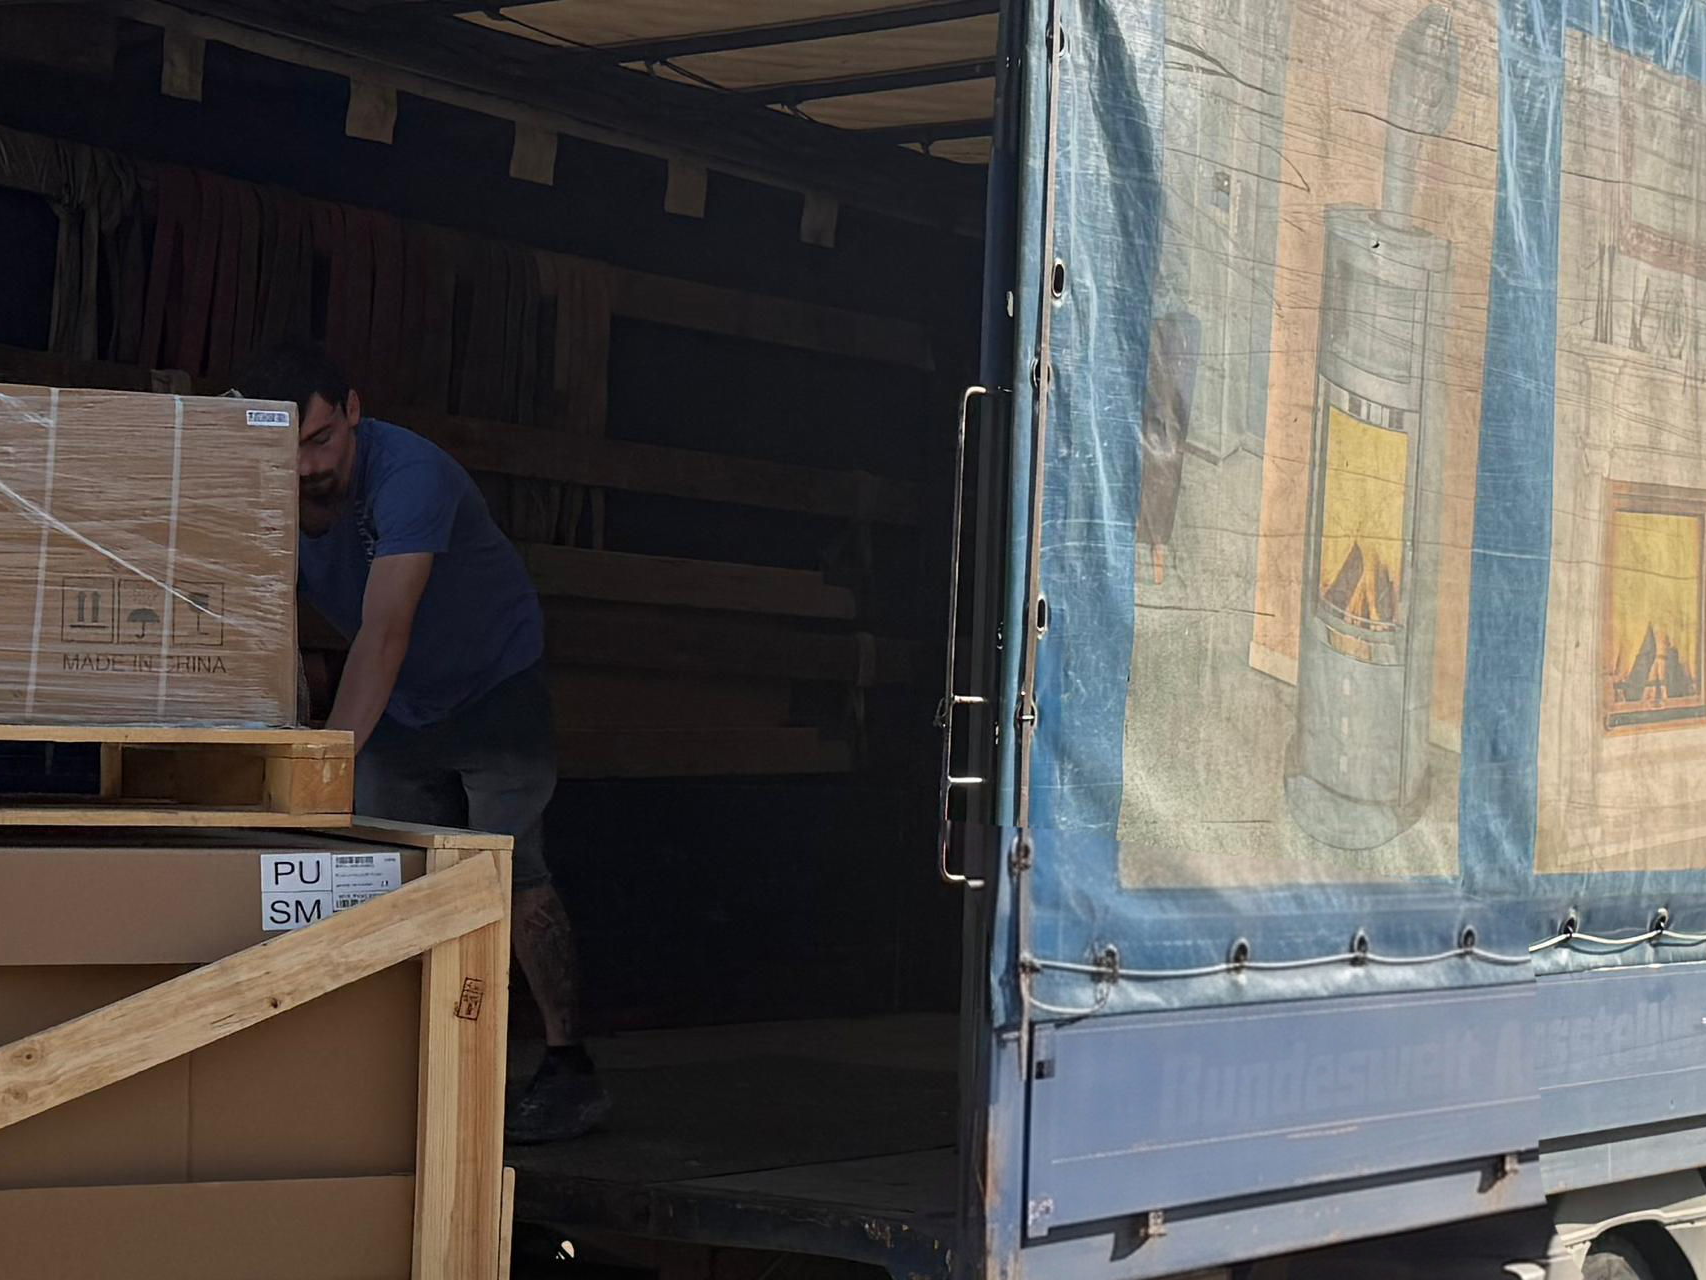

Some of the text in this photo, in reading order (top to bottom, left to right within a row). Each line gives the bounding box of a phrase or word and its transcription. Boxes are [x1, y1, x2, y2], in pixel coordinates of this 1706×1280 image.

[63, 654, 122, 671] MADE
[133, 654, 153, 671] IN
[274, 860, 321, 886] PU
[269, 899, 322, 924] SM
